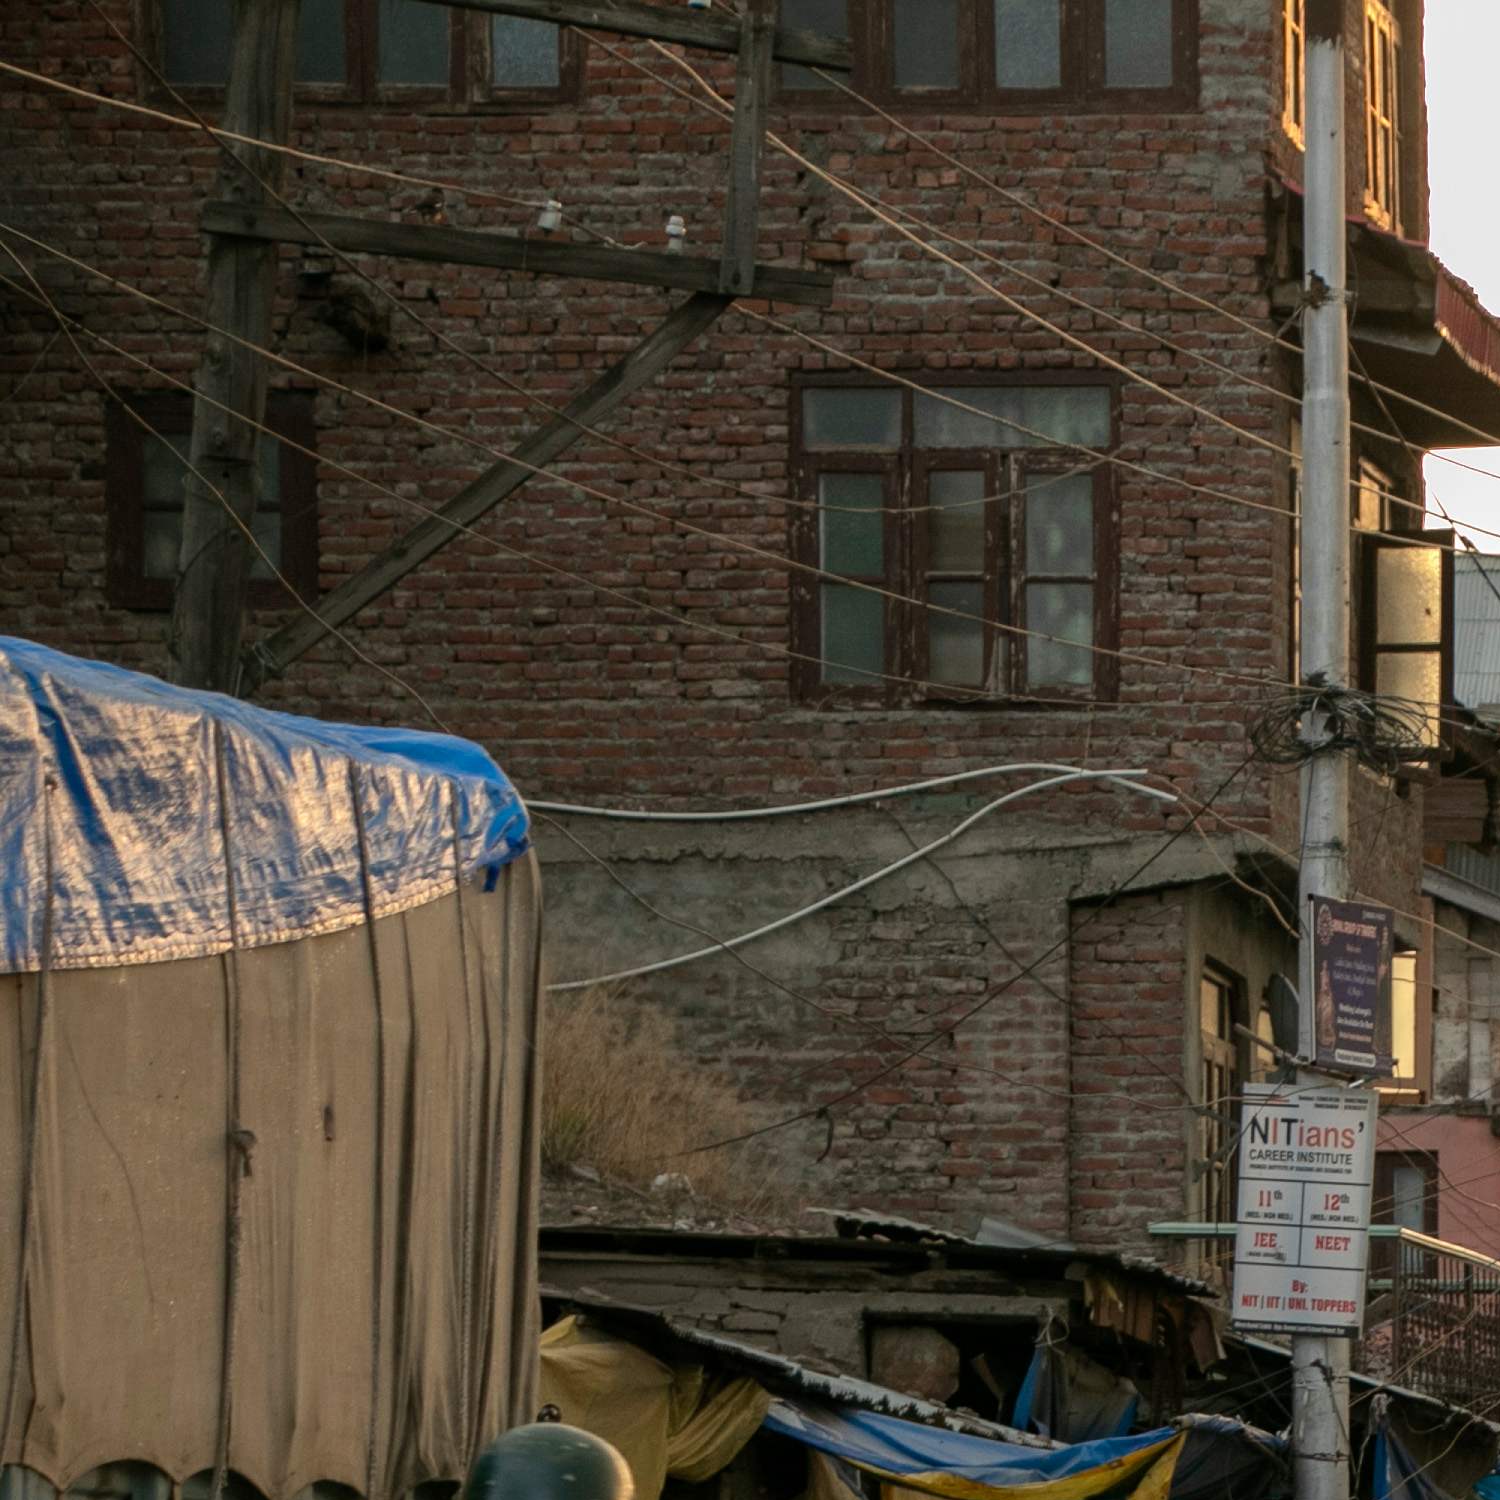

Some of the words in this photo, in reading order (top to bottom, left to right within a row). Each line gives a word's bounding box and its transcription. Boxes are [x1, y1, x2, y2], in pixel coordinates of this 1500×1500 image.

[1249, 1149, 1294, 1162] CAREER
[1297, 1152, 1352, 1165] INSTITUTE
[1253, 1232, 1277, 1248] JEE
[1315, 1235, 1351, 1251] NEET
[1241, 1294, 1259, 1308] NIT
[1311, 1299, 1357, 1313] TOPPERS
